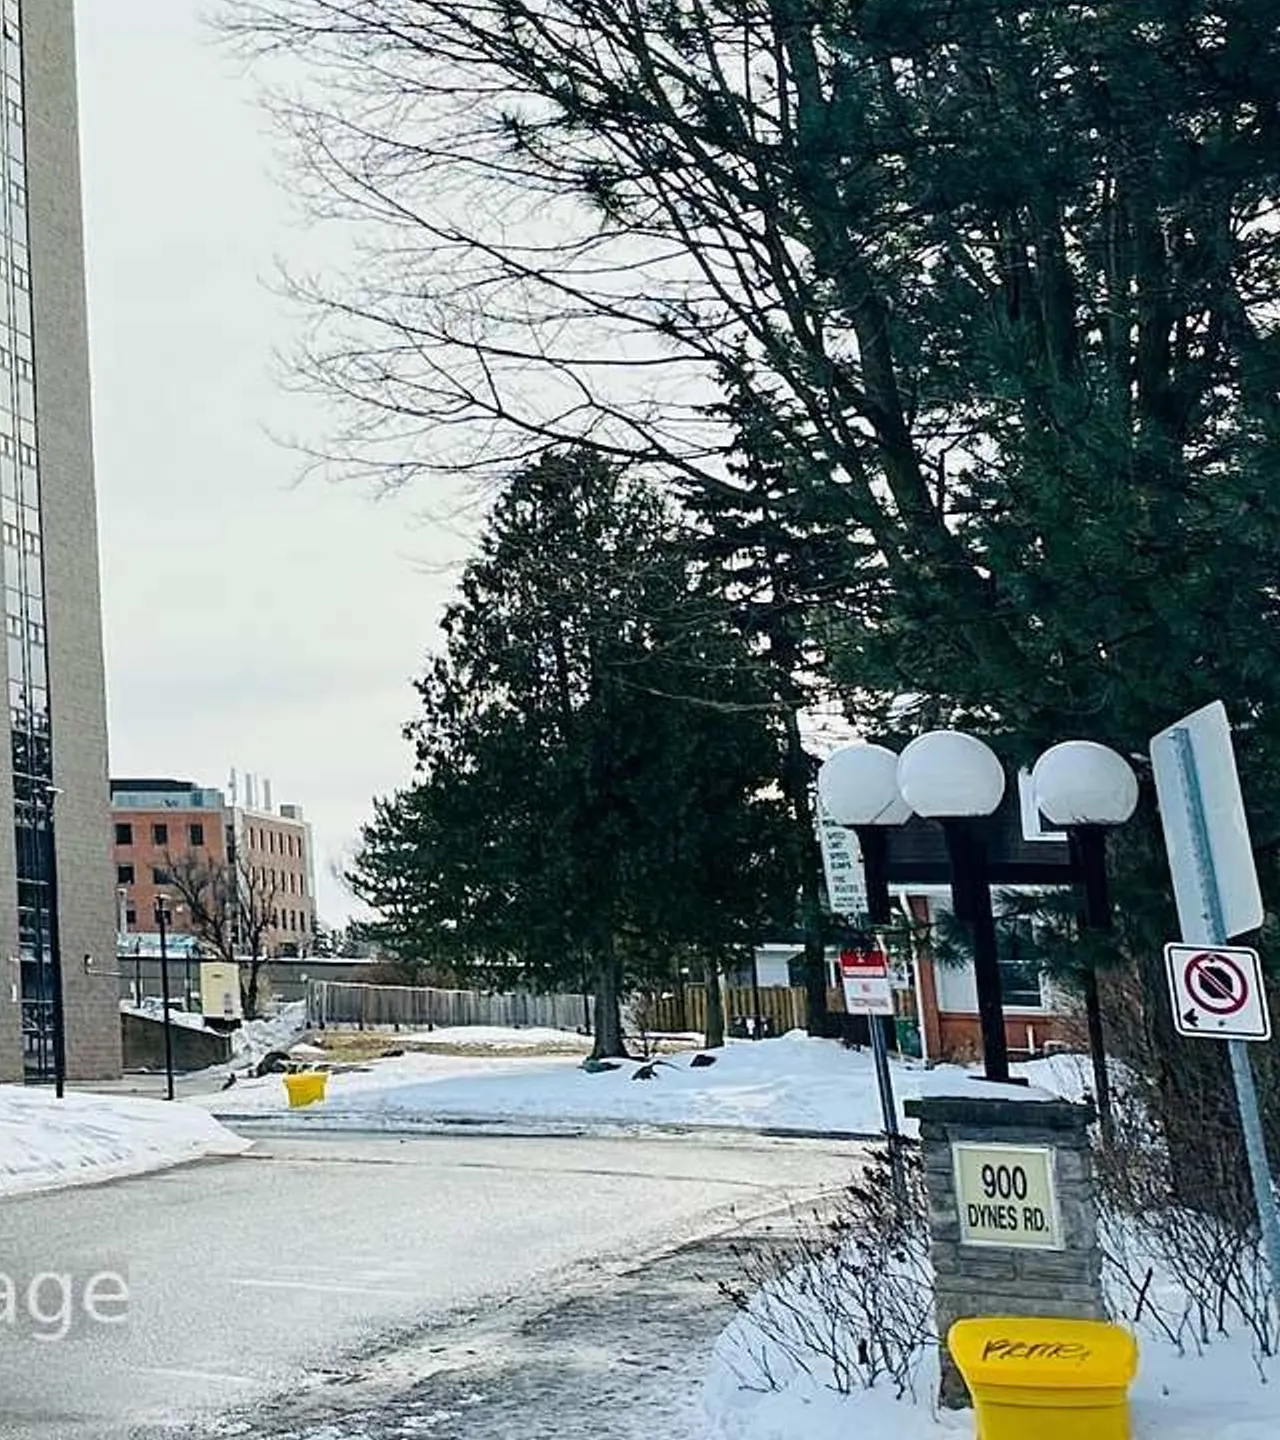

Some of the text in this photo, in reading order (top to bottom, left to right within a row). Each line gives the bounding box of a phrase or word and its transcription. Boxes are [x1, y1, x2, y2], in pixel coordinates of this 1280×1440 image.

[981, 1164, 1028, 1201] 900
[967, 1203, 1050, 1233] DYNES RD.
